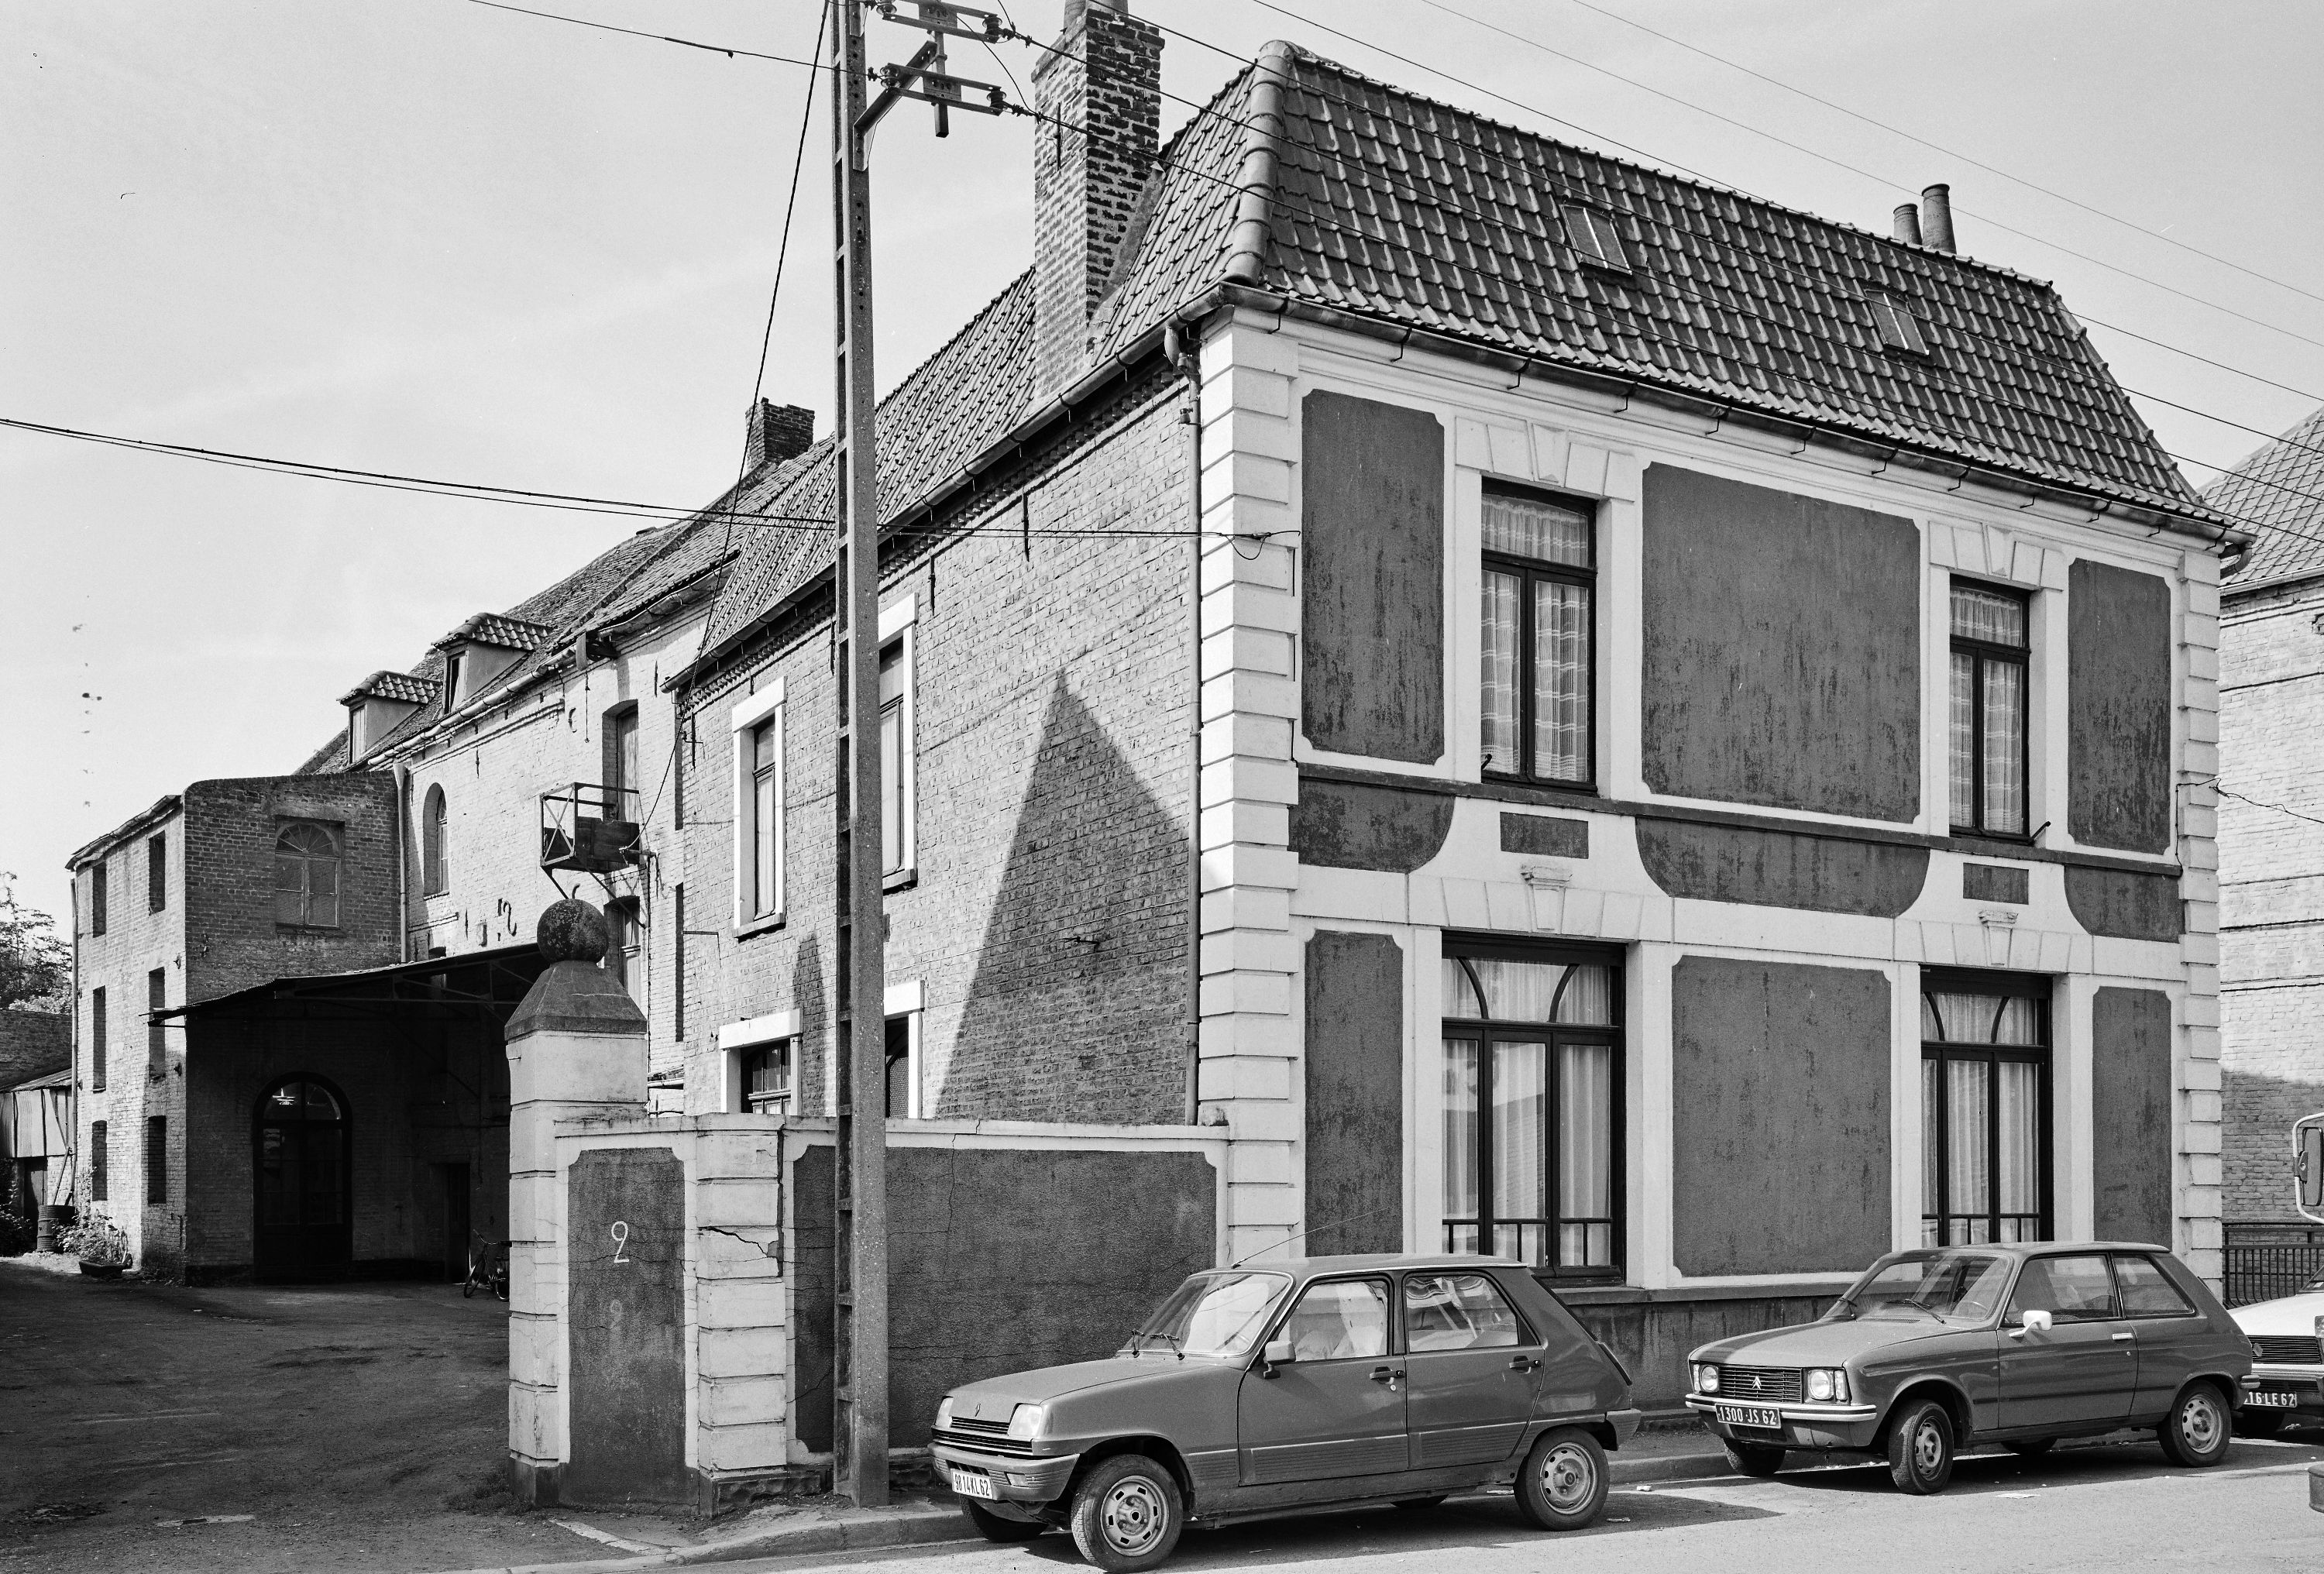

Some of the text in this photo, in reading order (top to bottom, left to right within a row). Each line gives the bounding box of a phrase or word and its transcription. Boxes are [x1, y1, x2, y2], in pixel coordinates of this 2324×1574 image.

[611, 1221, 629, 1263] 2
[2264, 1392, 2278, 1405] LE
[2281, 1393, 2295, 1407] 62
[1720, 1406, 1776, 1425] 1300 JS 62
[979, 1478, 990, 1497] 62
